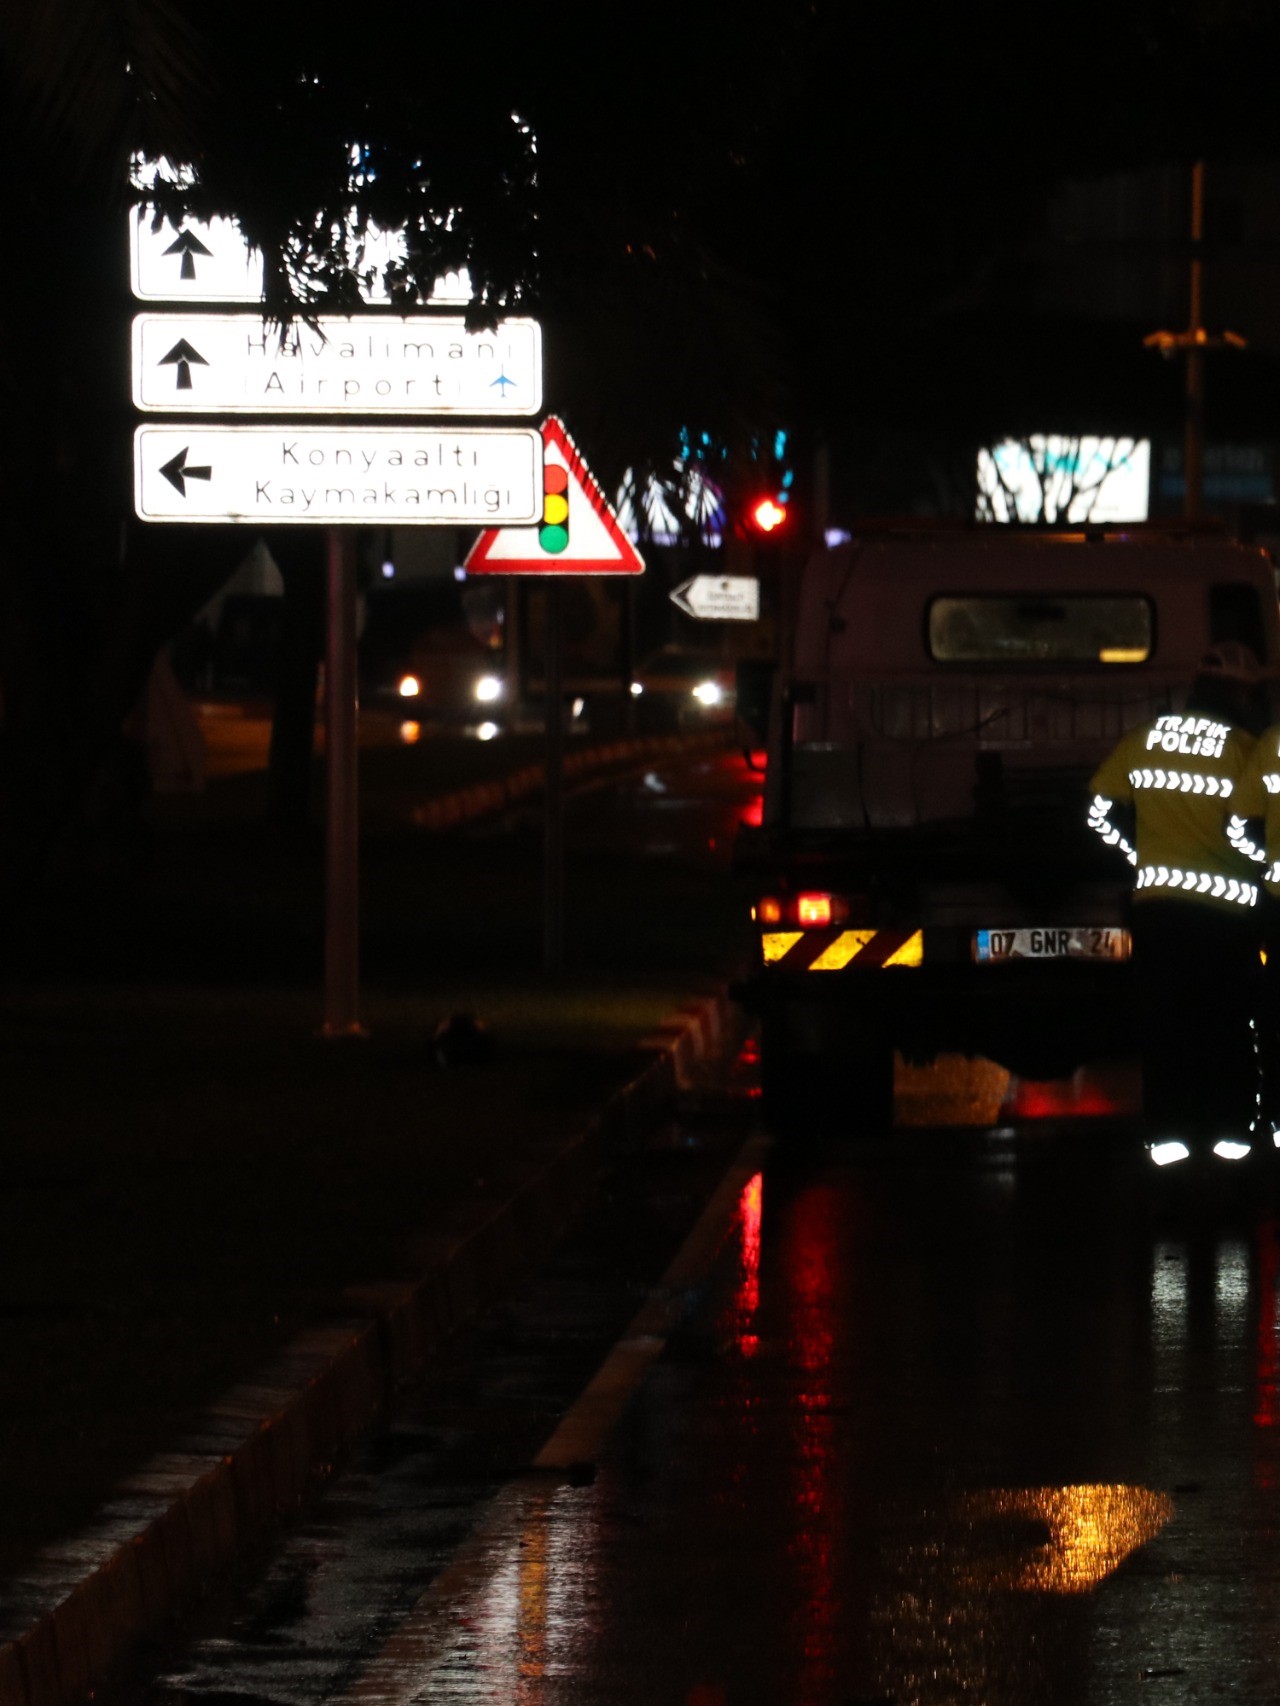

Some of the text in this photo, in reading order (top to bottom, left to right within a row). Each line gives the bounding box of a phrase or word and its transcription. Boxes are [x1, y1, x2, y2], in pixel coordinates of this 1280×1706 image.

[282, 442, 478, 473] Konyaaltı
[255, 480, 511, 512] Kaymakamlığı
[990, 932, 1016, 956] 07
[1031, 931, 1070, 954] GNR
